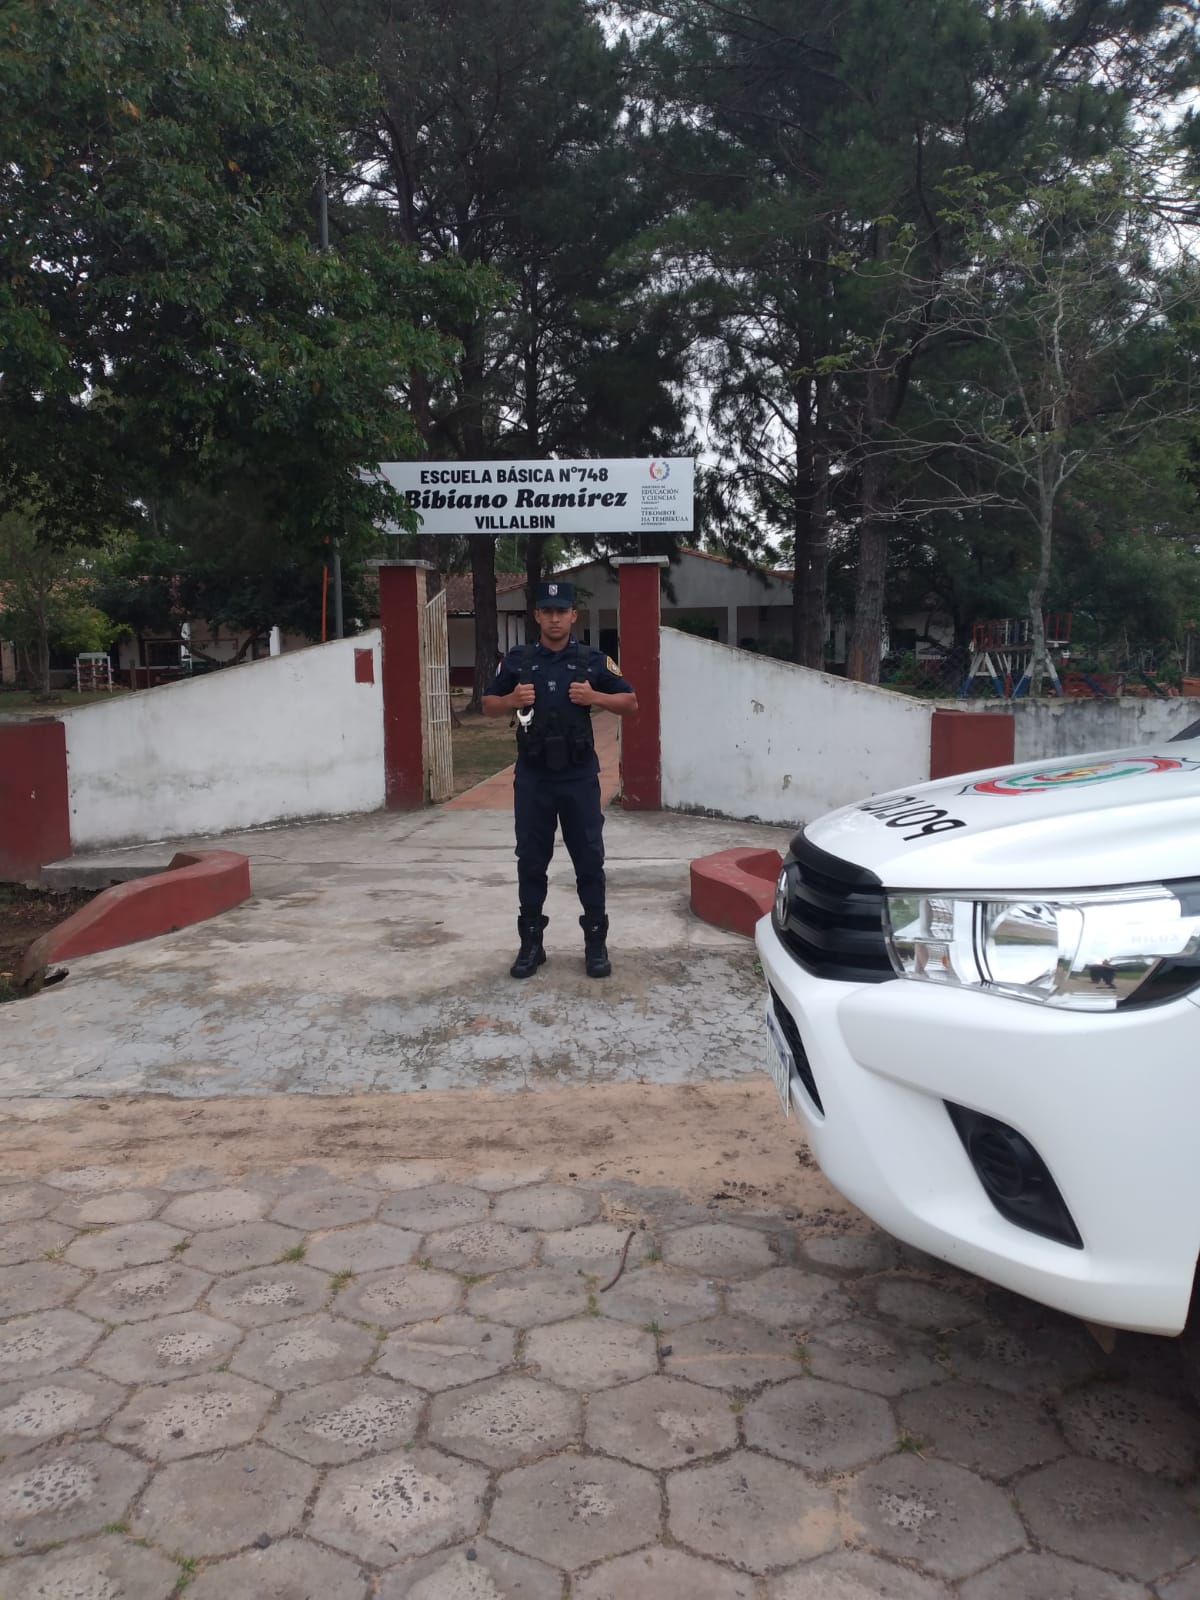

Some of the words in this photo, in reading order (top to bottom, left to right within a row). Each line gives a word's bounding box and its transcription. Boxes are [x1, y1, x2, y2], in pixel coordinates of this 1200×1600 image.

[420, 469, 492, 484] ESCUELA
[496, 466, 555, 483] BÁSICA
[405, 489, 508, 509] Bibiano
[475, 515, 555, 529] VILLALBIN
